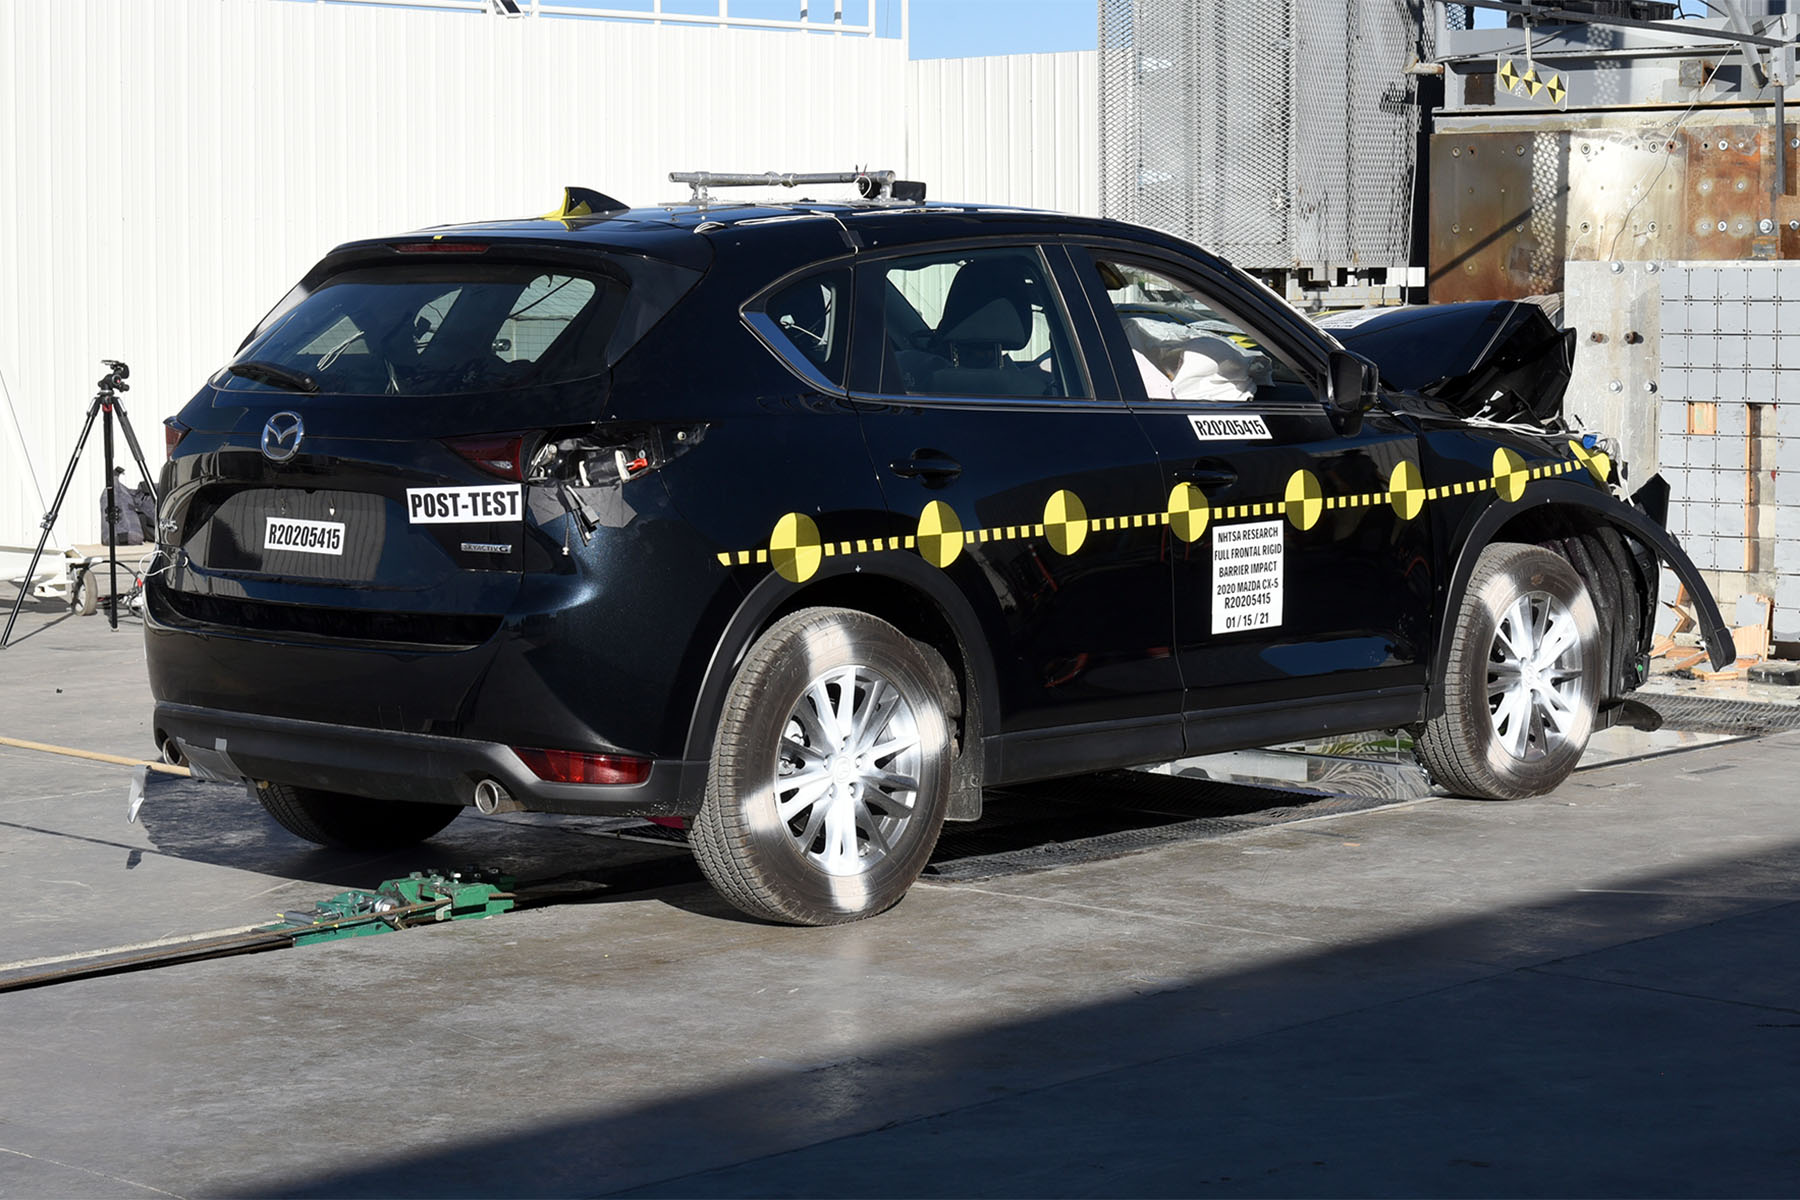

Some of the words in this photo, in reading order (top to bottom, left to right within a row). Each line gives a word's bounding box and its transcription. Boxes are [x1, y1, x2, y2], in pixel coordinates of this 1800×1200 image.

[1194, 420, 1266, 436] R20205415
[410, 491, 519, 518] POST-TEST
[268, 523, 341, 550] R20205415
[1217, 530, 1241, 543] NHTSA
[1242, 526, 1279, 541] RESEARCH
[1214, 549, 1230, 561] FULL
[1231, 545, 1261, 559] FRONTAL
[1262, 543, 1282, 556] RIGID
[1218, 564, 1250, 578] BARRIER
[1250, 560, 1277, 574] IMPACT
[1217, 583, 1236, 595] 2020
[1236, 580, 1261, 593] MAZDA
[1262, 577, 1279, 590] CX-5
[1224, 592, 1271, 609] R20205415
